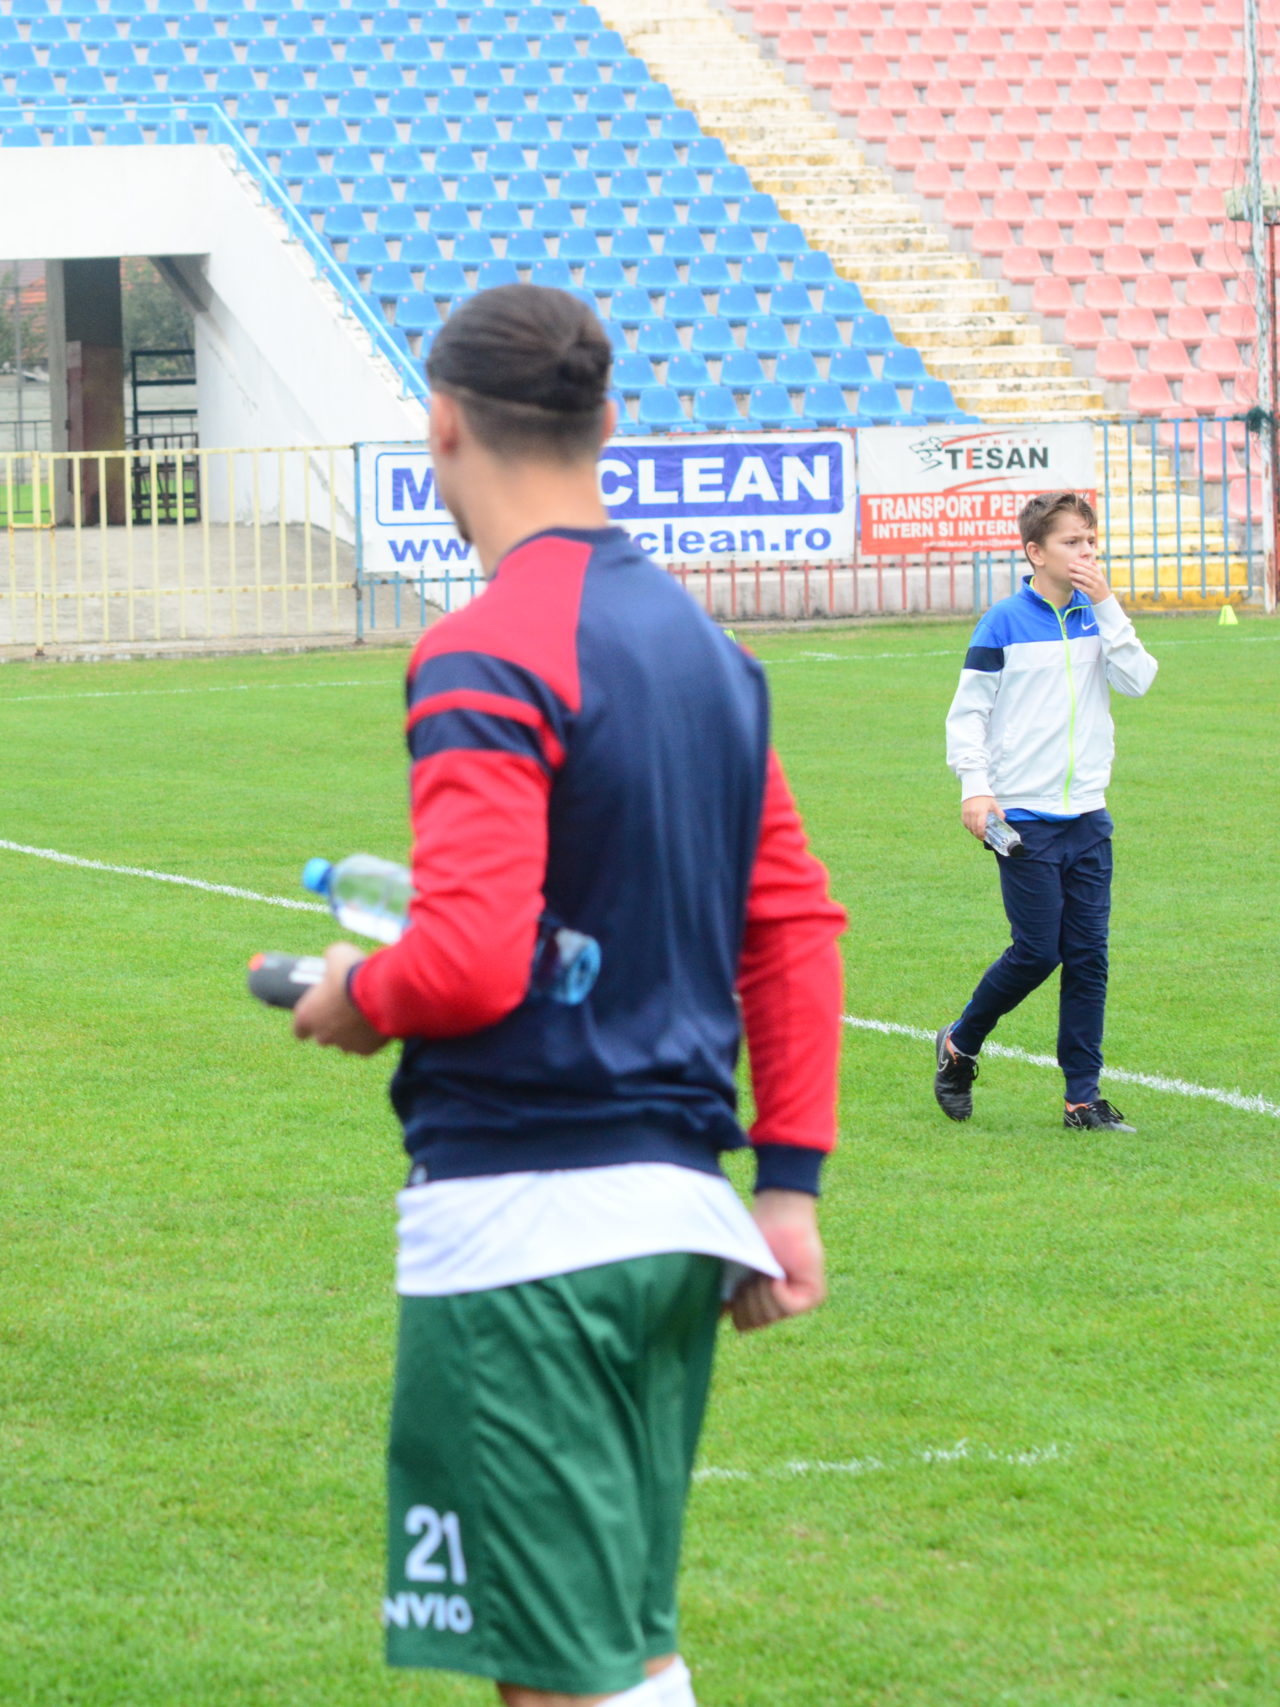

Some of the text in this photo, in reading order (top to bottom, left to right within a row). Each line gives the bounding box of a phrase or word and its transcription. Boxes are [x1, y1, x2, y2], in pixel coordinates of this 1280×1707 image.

[945, 447, 1048, 470] TESAN
[596, 455, 830, 506] CLEAN
[868, 495, 984, 520] TRANSPORT
[632, 524, 832, 556] clean.ro
[872, 523, 933, 539] INTERN
[938, 521, 954, 537] SI
[405, 1504, 468, 1585] 21
